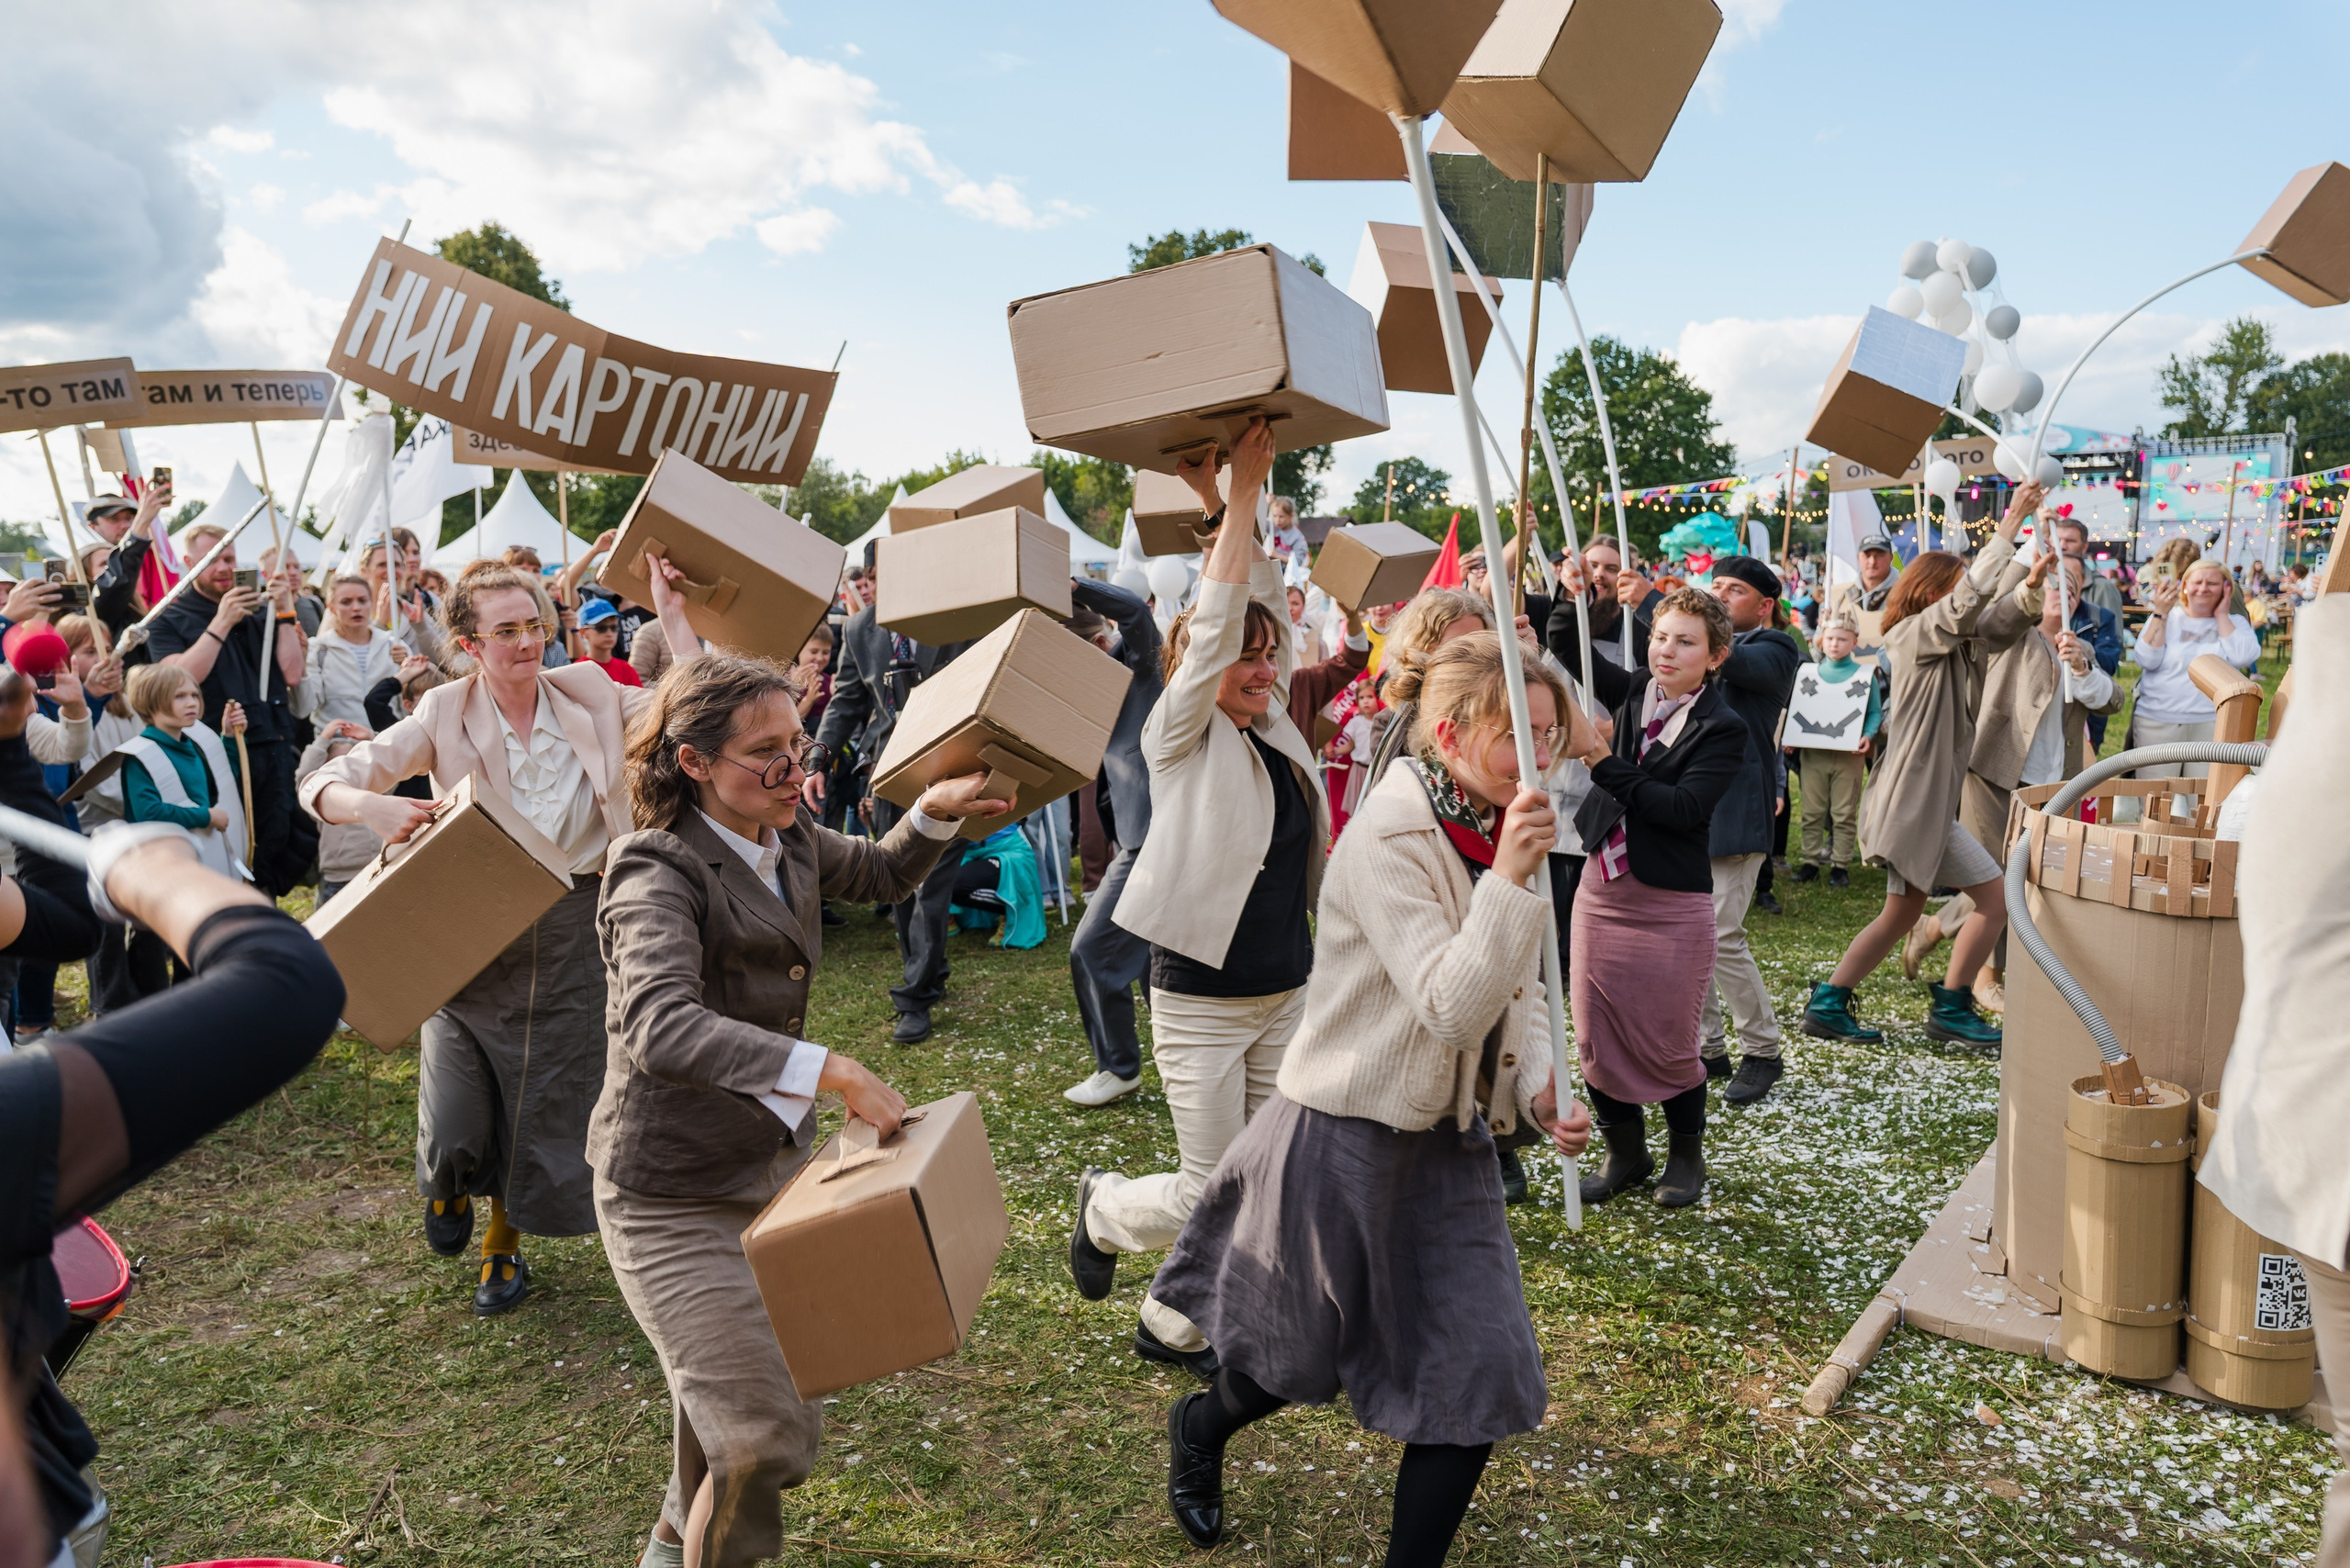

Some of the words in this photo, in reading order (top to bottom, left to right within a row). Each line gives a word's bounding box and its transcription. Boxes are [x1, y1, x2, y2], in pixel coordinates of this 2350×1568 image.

[342, 257, 495, 404] НИИ
[490, 320, 810, 475] КАРТОНИИ
[61, 377, 126, 404] там
[141, 384, 193, 405] ам
[203, 383, 224, 403] и
[230, 383, 324, 407] теперь
